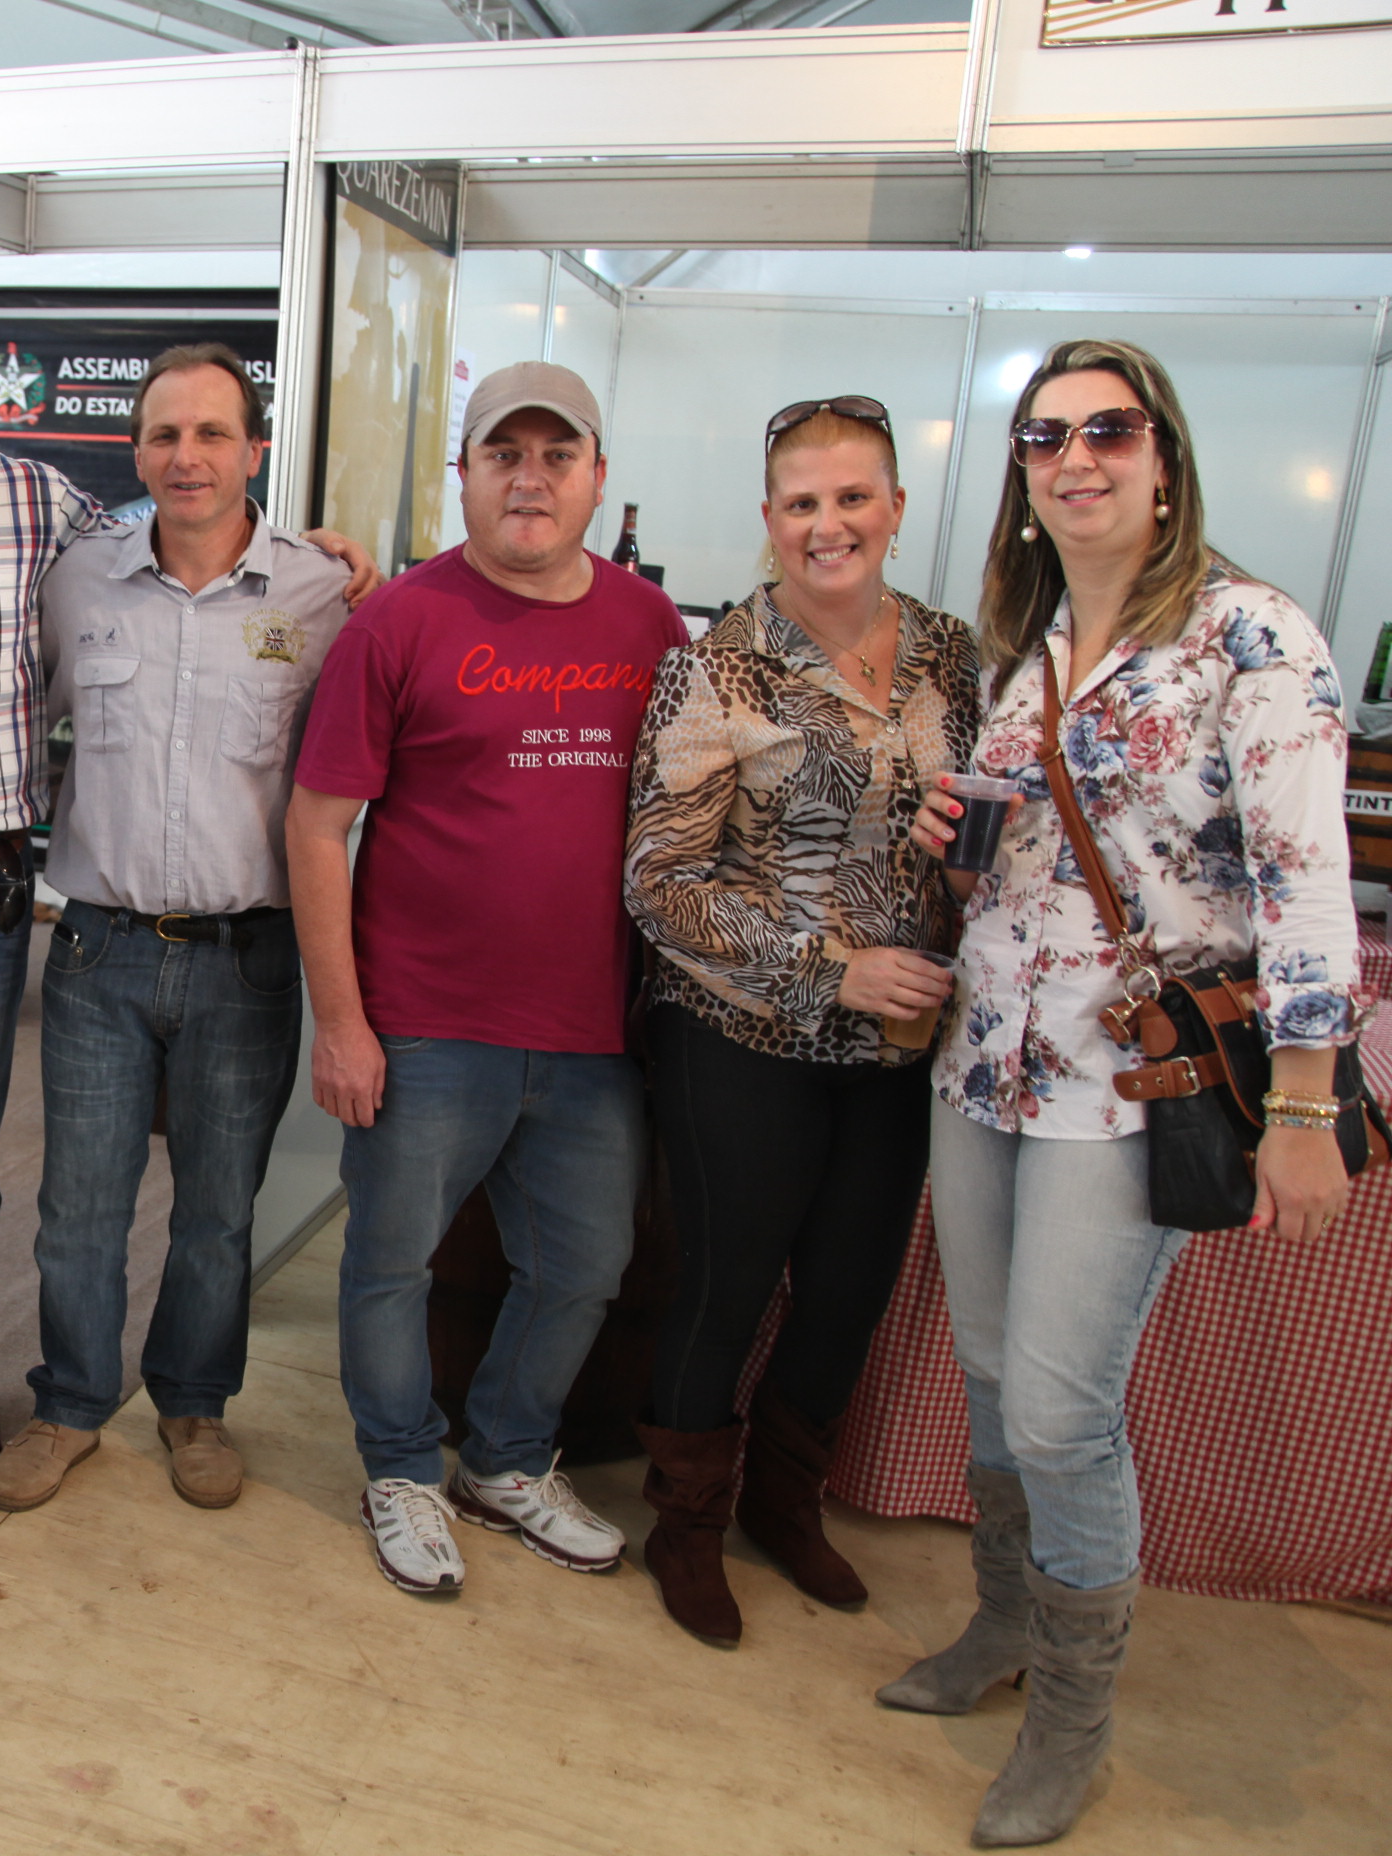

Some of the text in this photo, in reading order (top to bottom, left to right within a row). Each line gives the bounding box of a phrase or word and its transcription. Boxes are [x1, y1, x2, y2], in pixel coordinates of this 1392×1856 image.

[55, 396, 134, 416] DO ESTA
[458, 643, 654, 714] Company
[522, 728, 612, 744] SINCE 1998
[507, 751, 628, 768] THE ORIGINAL
[1344, 794, 1392, 811] TINT
